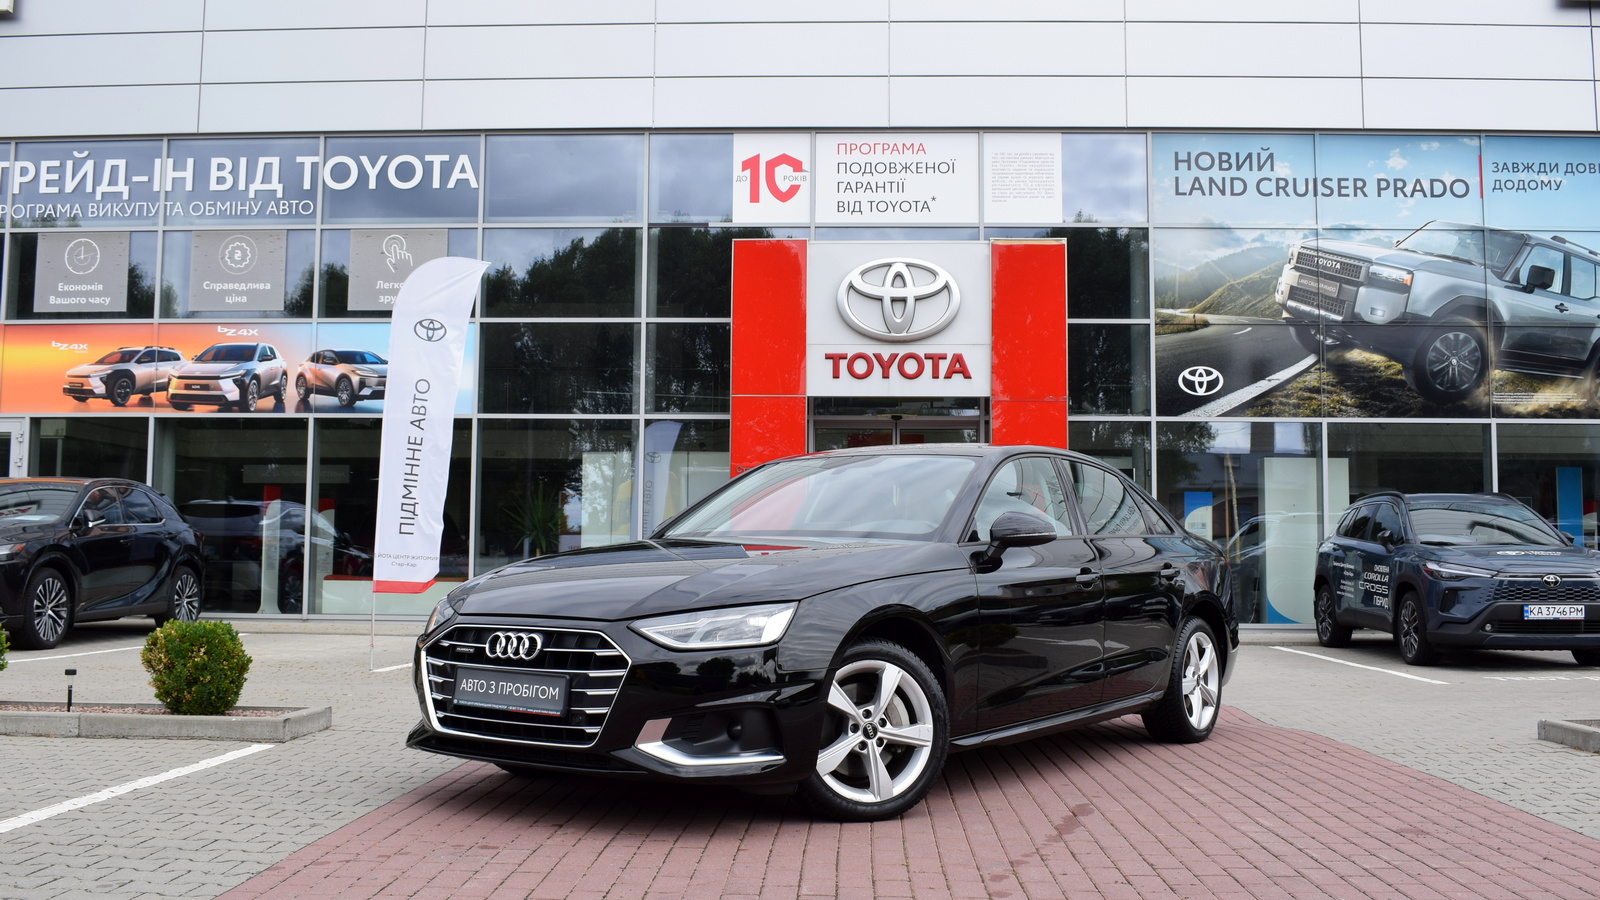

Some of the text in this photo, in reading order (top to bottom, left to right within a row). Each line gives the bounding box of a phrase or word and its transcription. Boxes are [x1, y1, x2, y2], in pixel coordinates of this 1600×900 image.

[837, 142, 926, 155] ПРОГРАМА
[1174, 147, 1274, 172] НОВИЙ
[837, 158, 956, 176] ПОДОВЖЕНОЇ
[1492, 162, 1600, 176] ЗАВЖДИ ДОВ
[209, 156, 284, 198] ВІД
[296, 154, 478, 190] TOYOTA
[837, 178, 906, 193] ГАРАНТІЇ
[1174, 176, 1470, 198] LAND CRUISER PRADO
[1492, 179, 1562, 192] ДОДОМУ
[88, 202, 160, 217] ВИКУПУ
[164, 202, 184, 216] ТА
[190, 200, 262, 216] ОБМІНУ
[266, 200, 314, 215] АВТО
[837, 200, 863, 215] ВІД
[1314, 257, 1340, 269] TOYOTA
[58, 282, 103, 291] Економія
[203, 281, 271, 291] Справедлива
[49, 296, 110, 305] Вашого часу
[225, 294, 247, 304] ціна
[824, 352, 972, 380] TOYOTA
[399, 379, 430, 535] ПІДМІННЕ АВТО
[1364, 572, 1389, 582] COROLLA
[1358, 581, 1388, 594] CROSS
[1529, 606, 1584, 616] KA 3746 PM
[460, 678, 487, 693] АВТО
[498, 682, 559, 700] ПРОБІГОМ
